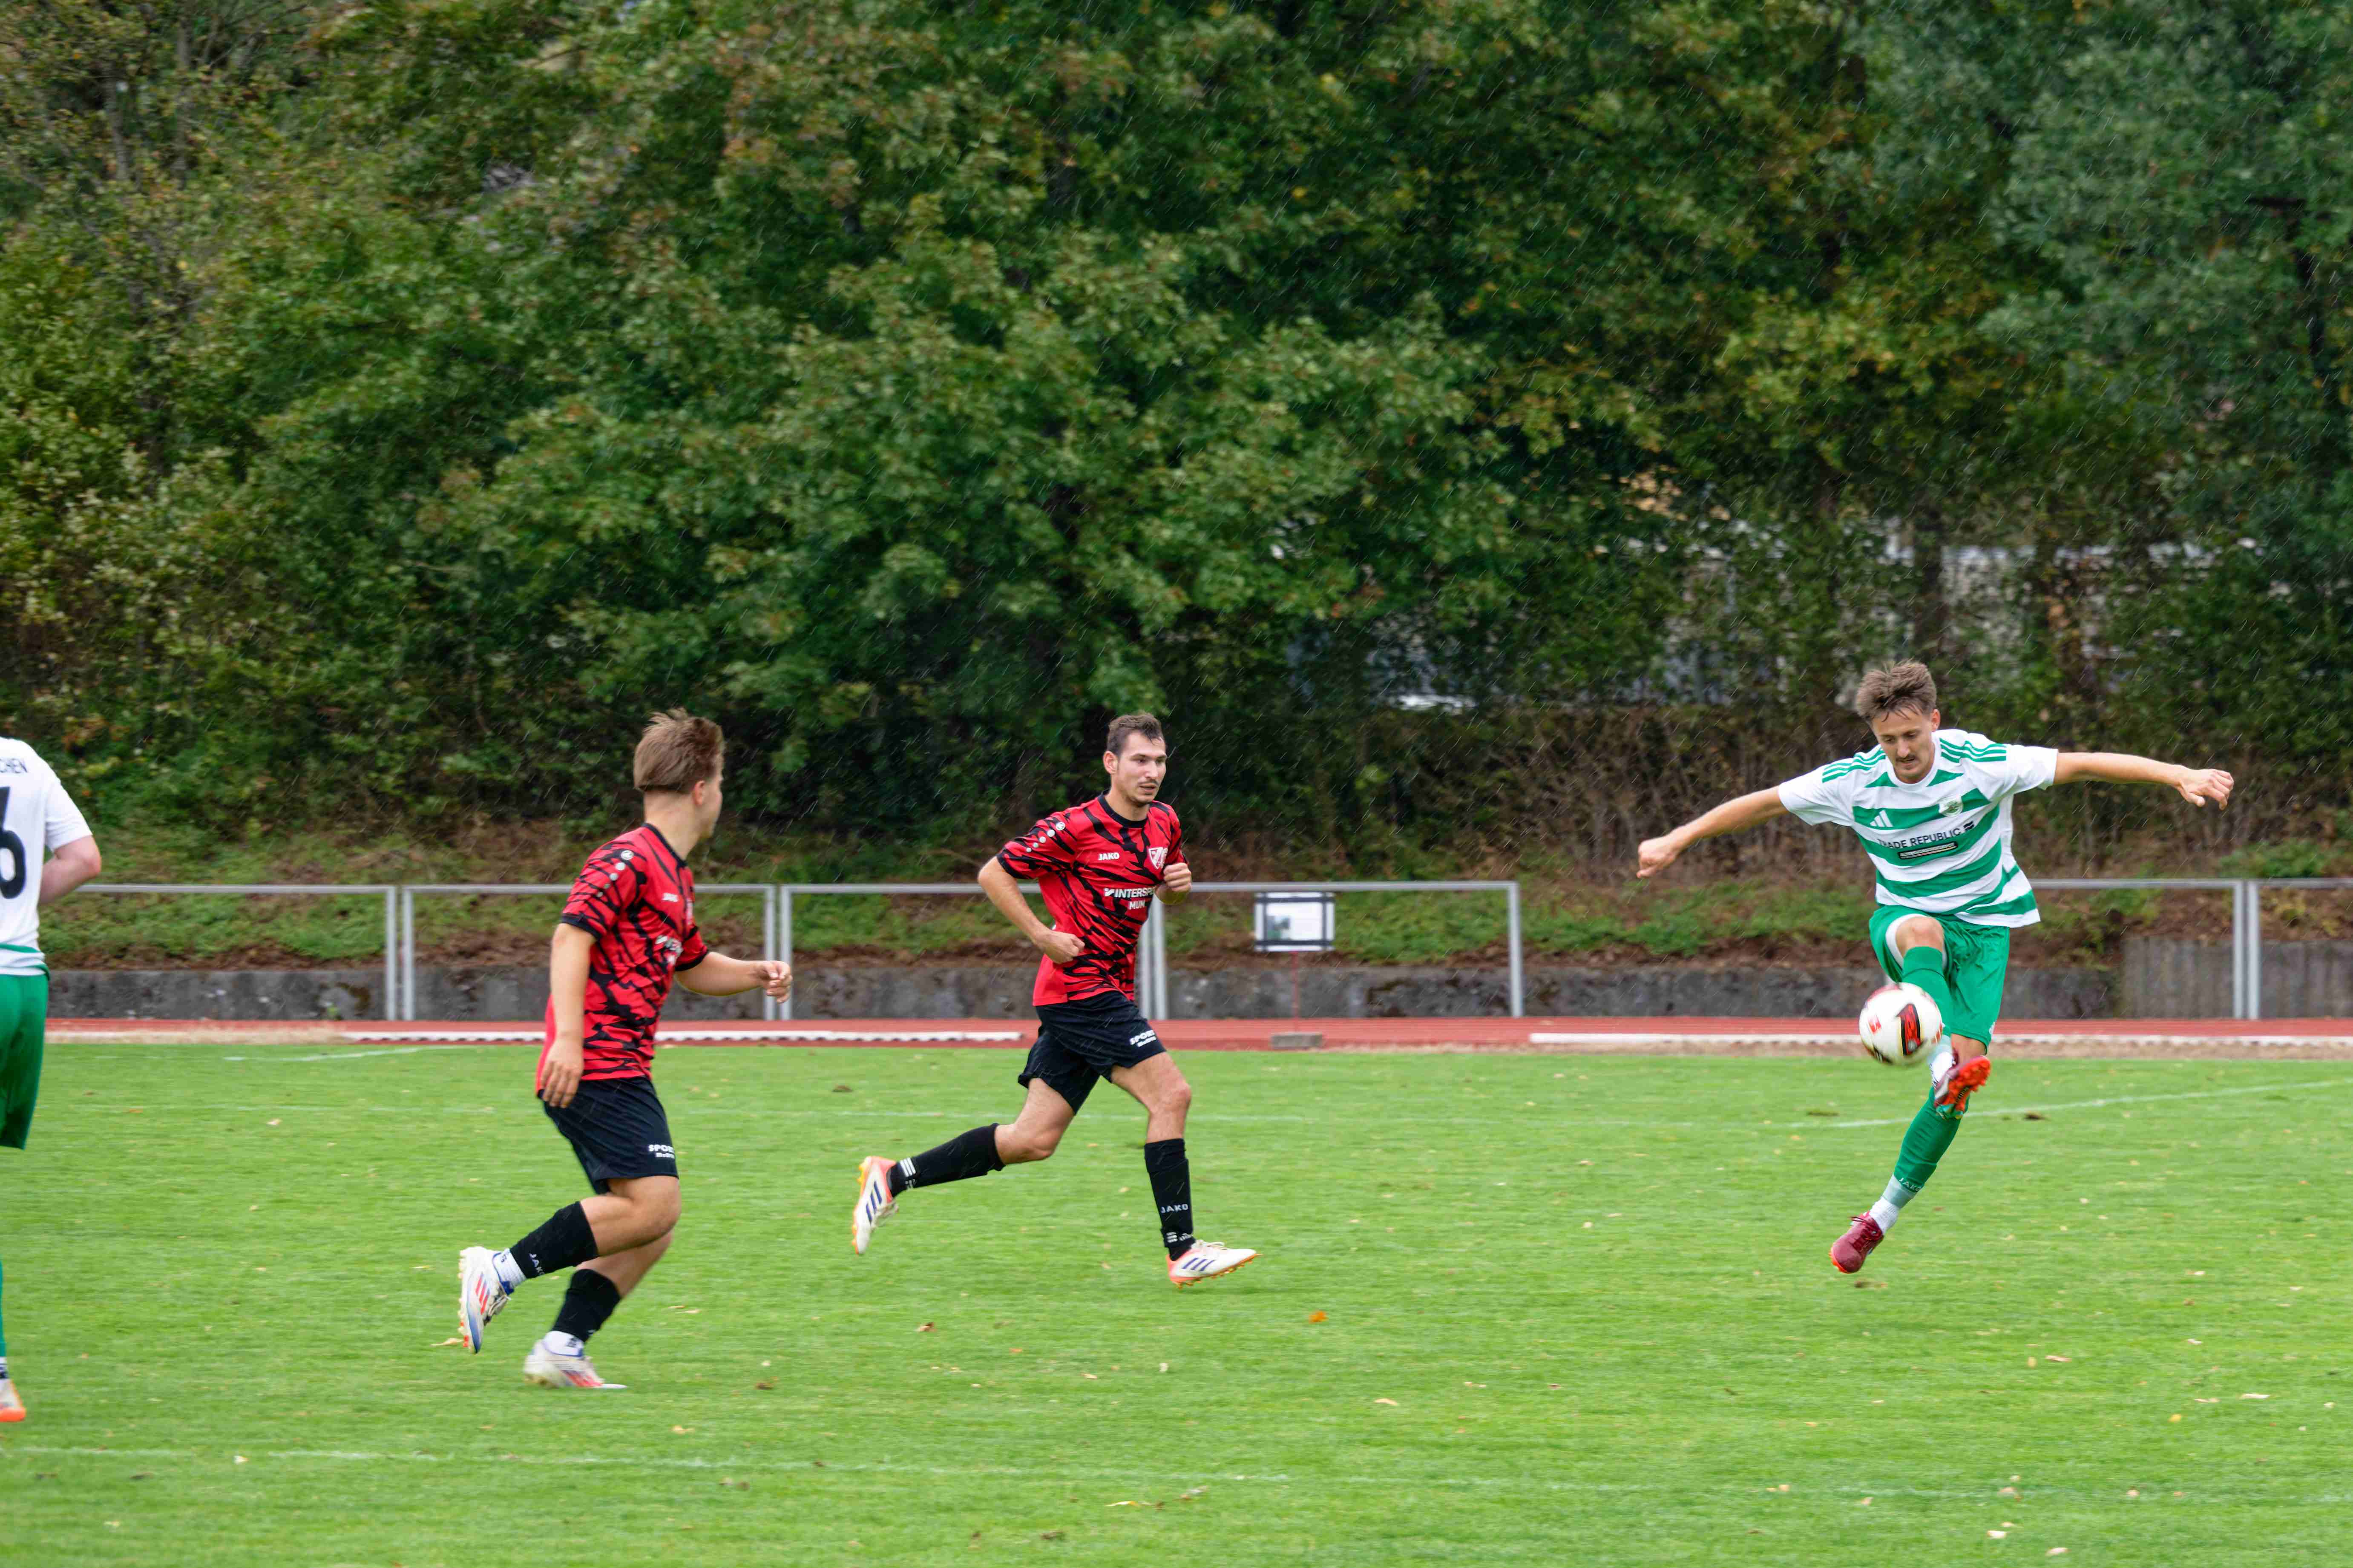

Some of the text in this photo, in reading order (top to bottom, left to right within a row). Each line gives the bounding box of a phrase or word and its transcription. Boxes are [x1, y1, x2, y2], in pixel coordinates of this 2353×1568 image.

[1910, 828, 1961, 847] REPUBLIC
[1098, 852, 1120, 861] JAKO
[1161, 1203, 1188, 1213] JAKO
